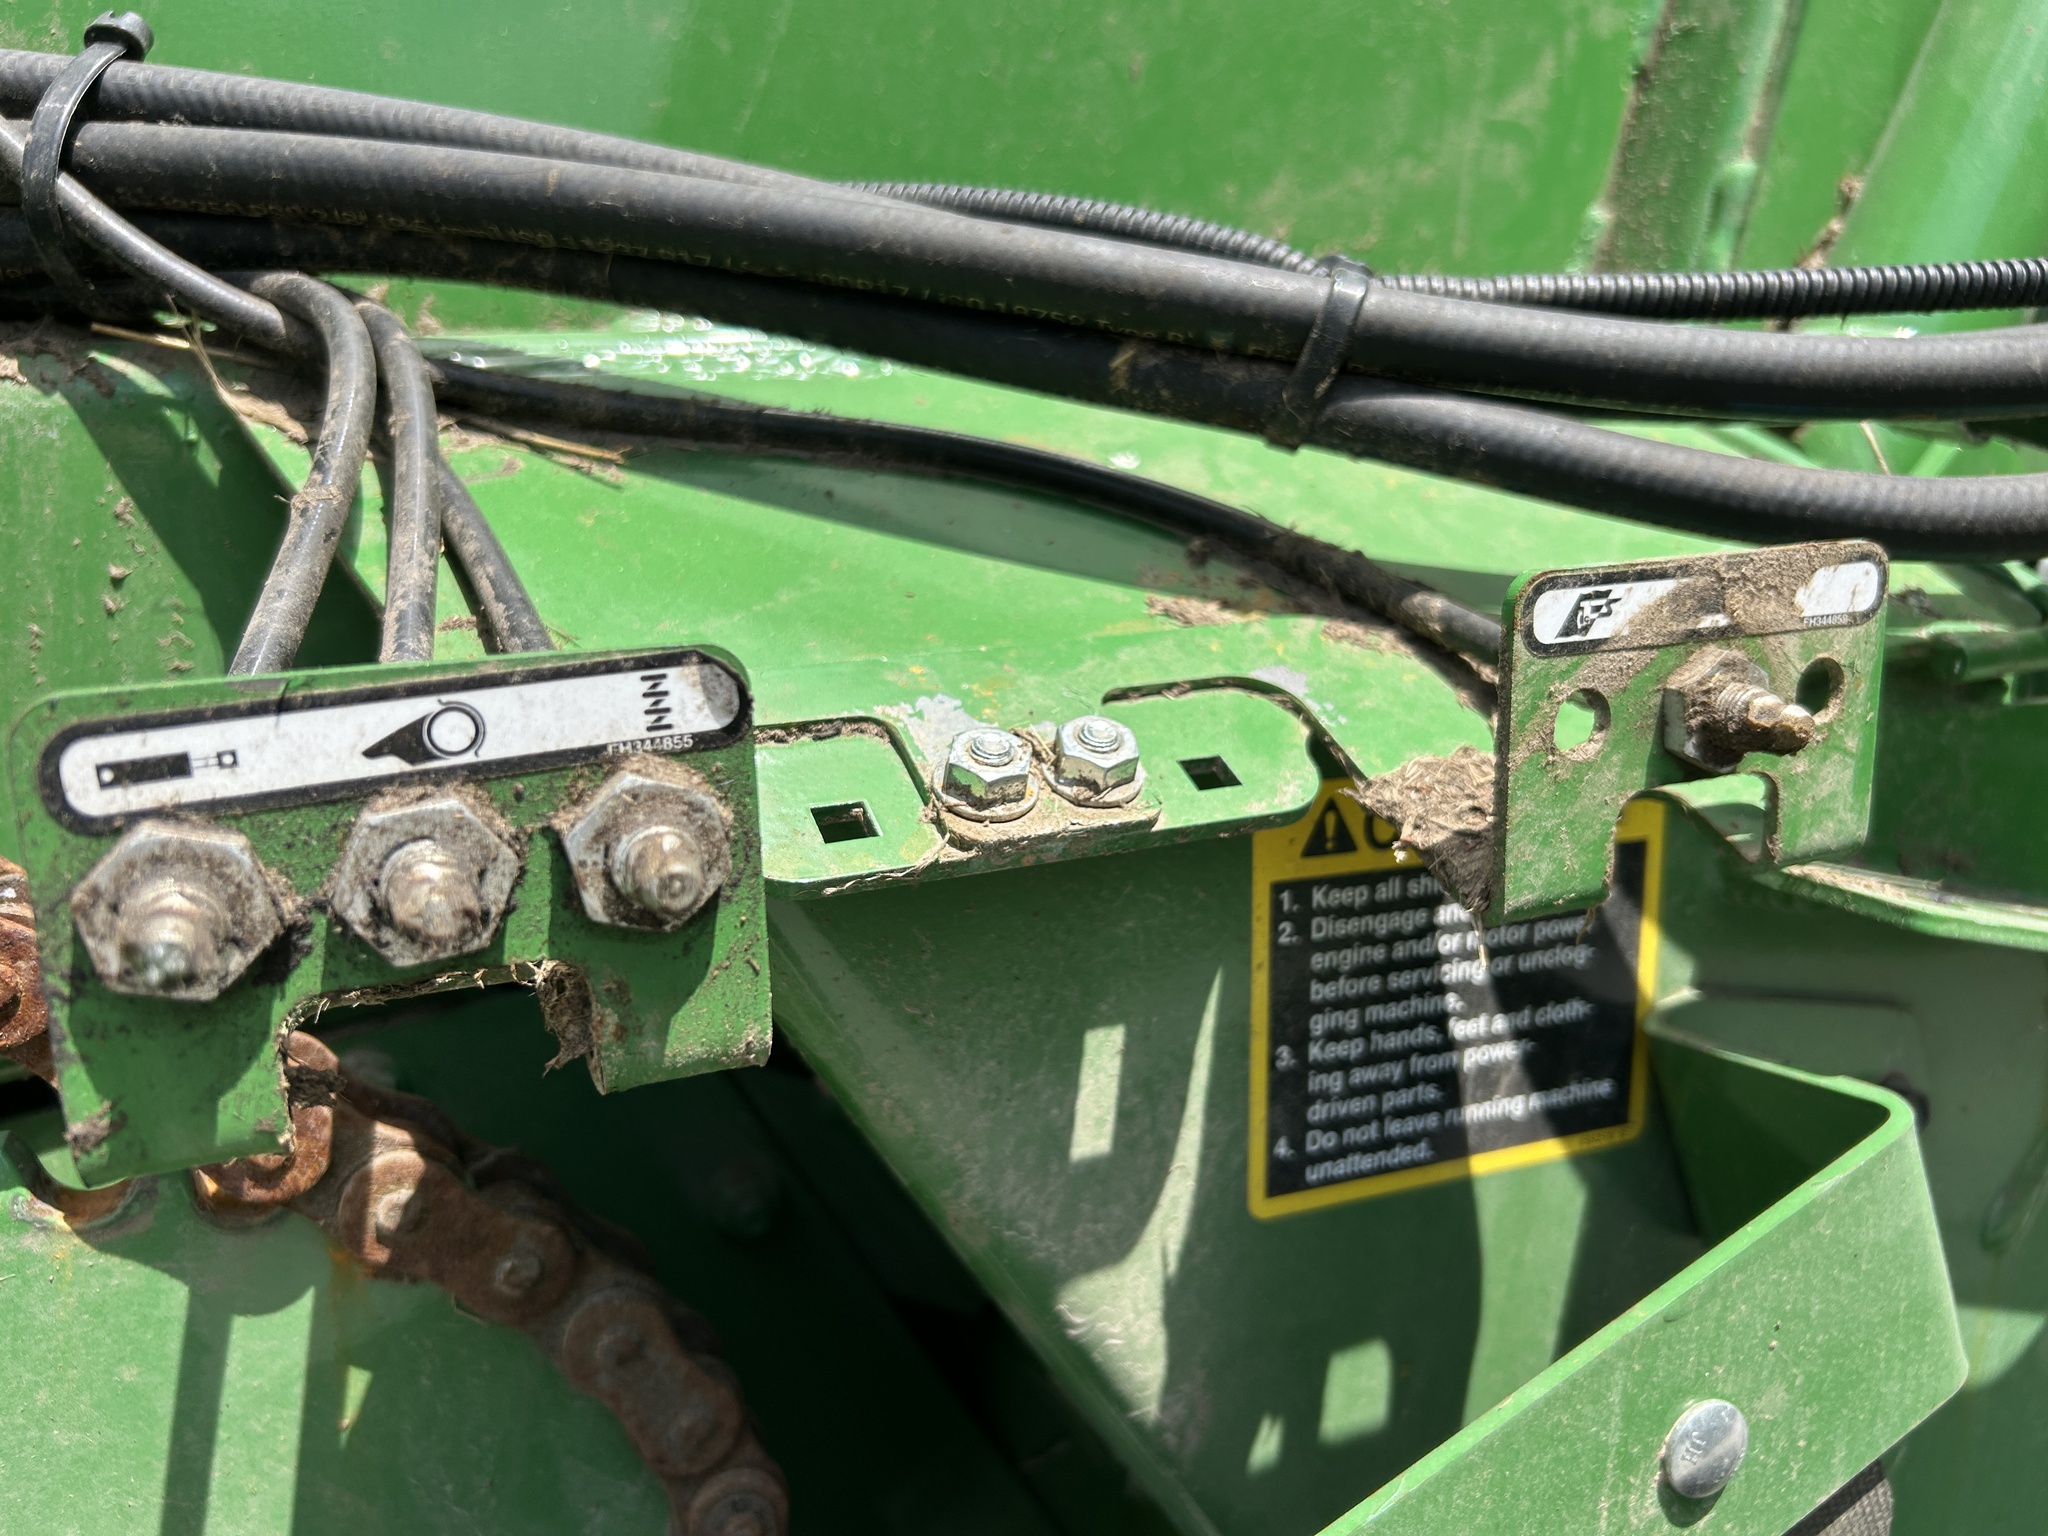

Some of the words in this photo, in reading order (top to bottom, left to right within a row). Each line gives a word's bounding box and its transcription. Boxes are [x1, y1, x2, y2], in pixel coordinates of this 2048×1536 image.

[1279, 889, 1299, 913] 1.
[1311, 883, 1370, 911] Keep
[1375, 875, 1402, 902] all
[1278, 921, 1300, 946] 2.
[1310, 908, 1431, 942] Disengage
[1310, 943, 1388, 973] engine
[1310, 975, 1385, 1003] before
[1387, 957, 1489, 987] servicing
[1490, 954, 1515, 976] or
[1309, 1007, 1361, 1038] ging
[1365, 992, 1466, 1025] machine.
[1275, 1045, 1297, 1071] 3.
[1308, 1037, 1367, 1064] Keep
[1491, 1005, 1531, 1035] and
[1308, 1070, 1346, 1096] ing
[1348, 1059, 1405, 1087] away
[1410, 1051, 1460, 1076] from
[1273, 1136, 1297, 1161] 4.
[1305, 1128, 1341, 1154] Do
[1342, 1118, 1381, 1147] not
[1384, 1110, 1443, 1139] leave
[1445, 1095, 1527, 1128] running
[1528, 1076, 1616, 1112] machine
[1307, 1095, 1379, 1126] driven
[1305, 1137, 1436, 1185] unattended.
